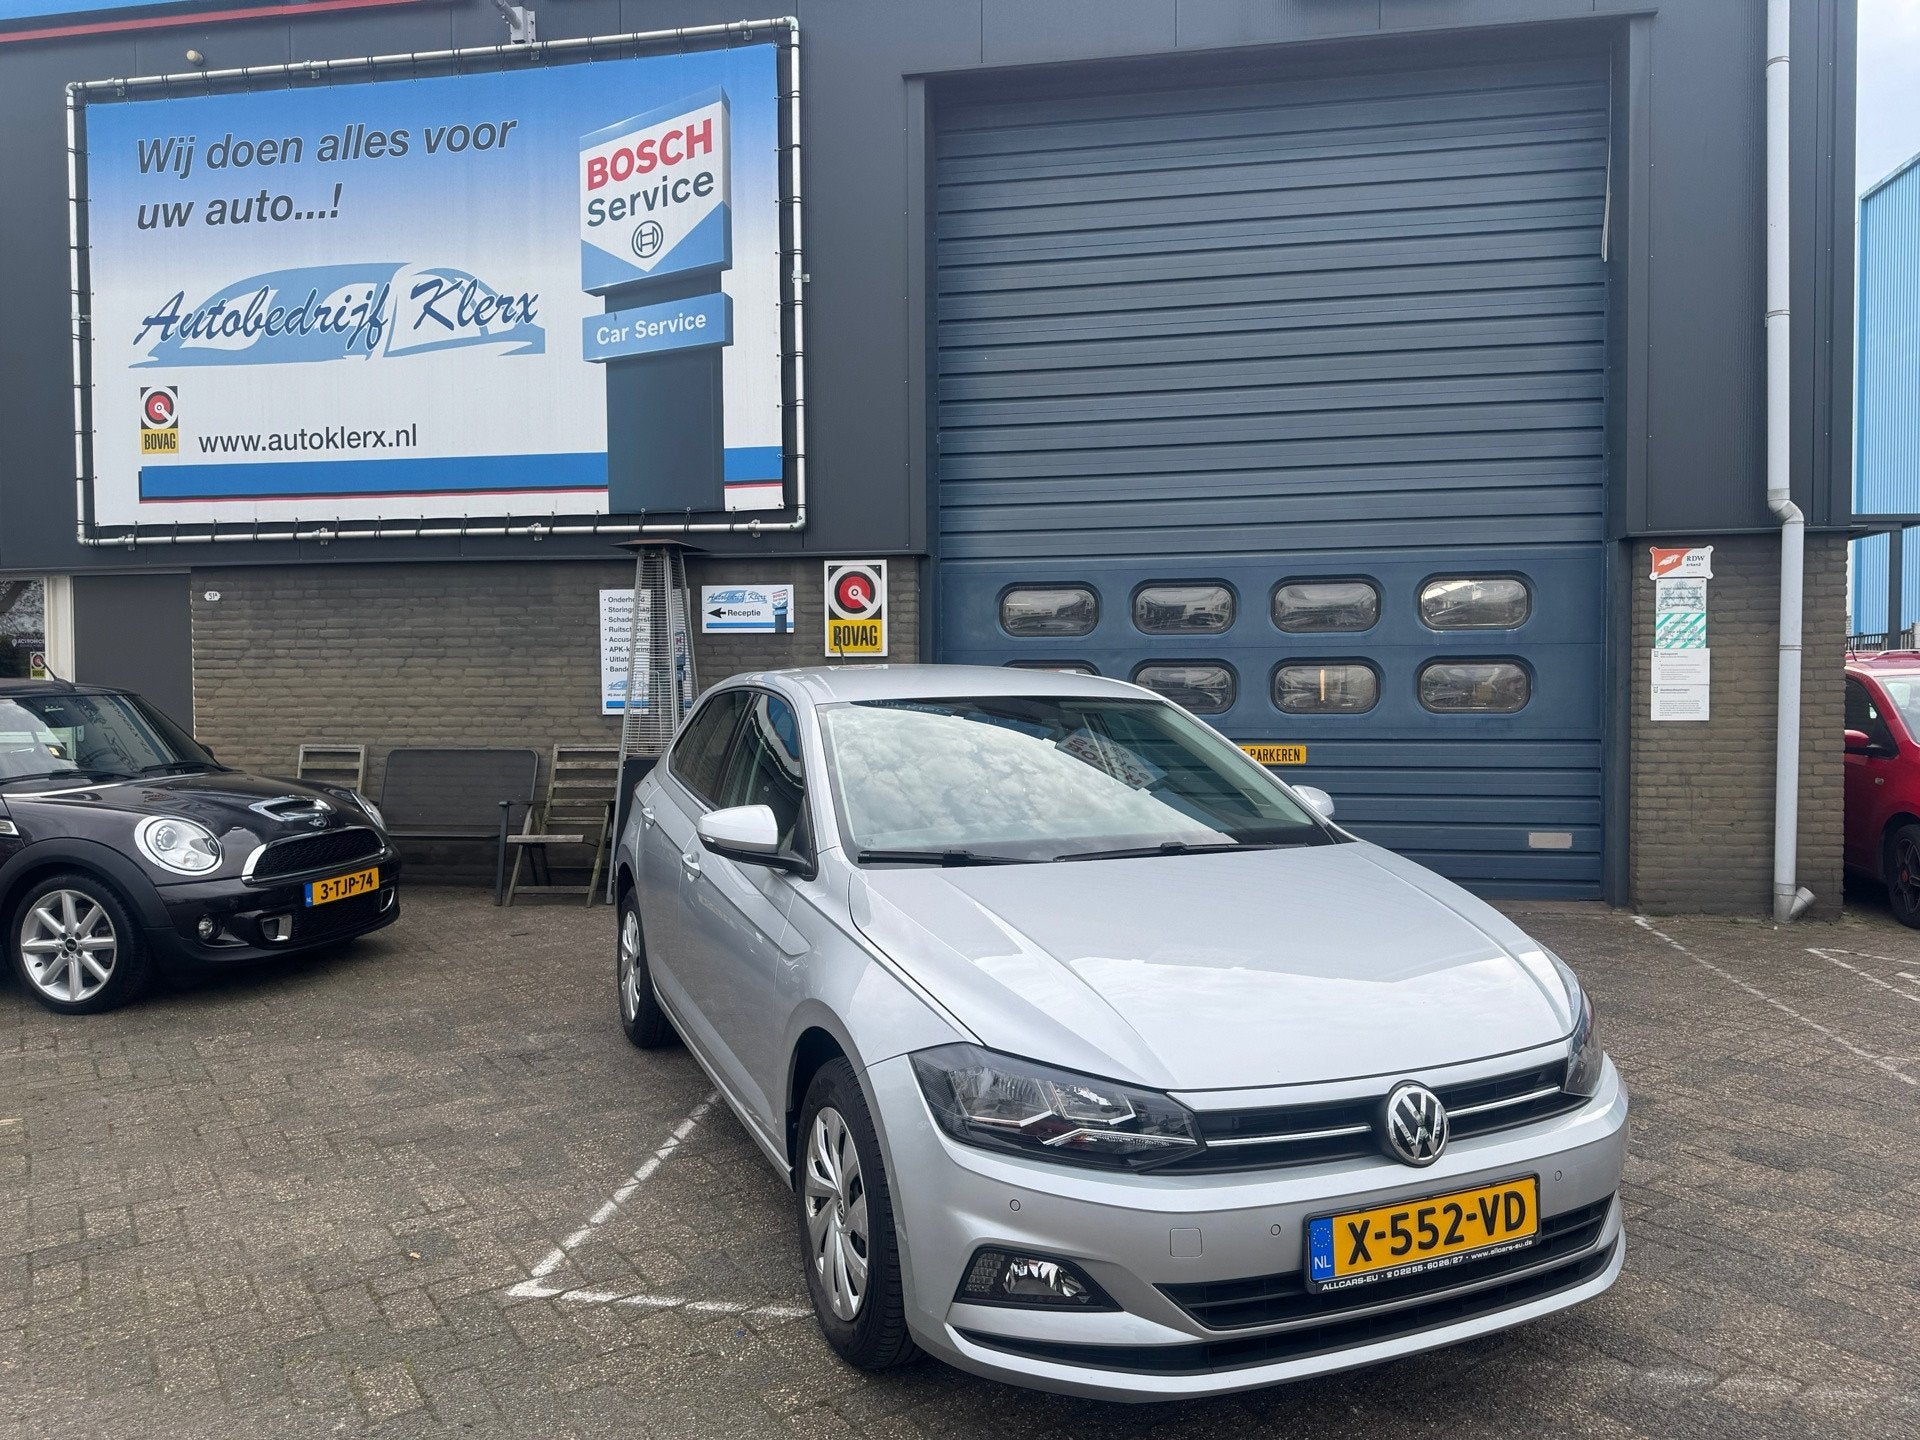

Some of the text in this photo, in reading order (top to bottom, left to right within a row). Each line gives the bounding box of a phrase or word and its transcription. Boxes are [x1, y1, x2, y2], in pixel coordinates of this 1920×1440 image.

[137, 119, 518, 180] Wij doen alles voor
[587, 118, 713, 191] BOSCH
[587, 171, 714, 227] Service
[137, 201, 195, 229] uw
[133, 278, 540, 350] Autobedrijf Klerx
[596, 313, 707, 345] Car Service
[144, 433, 176, 450] BOVAG
[198, 423, 417, 453] www.autoklerx.nl
[727, 609, 761, 617] Receptie
[833, 625, 878, 647] BOVAG
[1250, 748, 1300, 762] PARKEREN
[320, 871, 374, 900] 3-TJP-74
[1347, 1190, 1526, 1266] X-552-VD
[1314, 1255, 1332, 1269] NL
[1321, 1274, 1379, 1291] ALLCARS-EU
